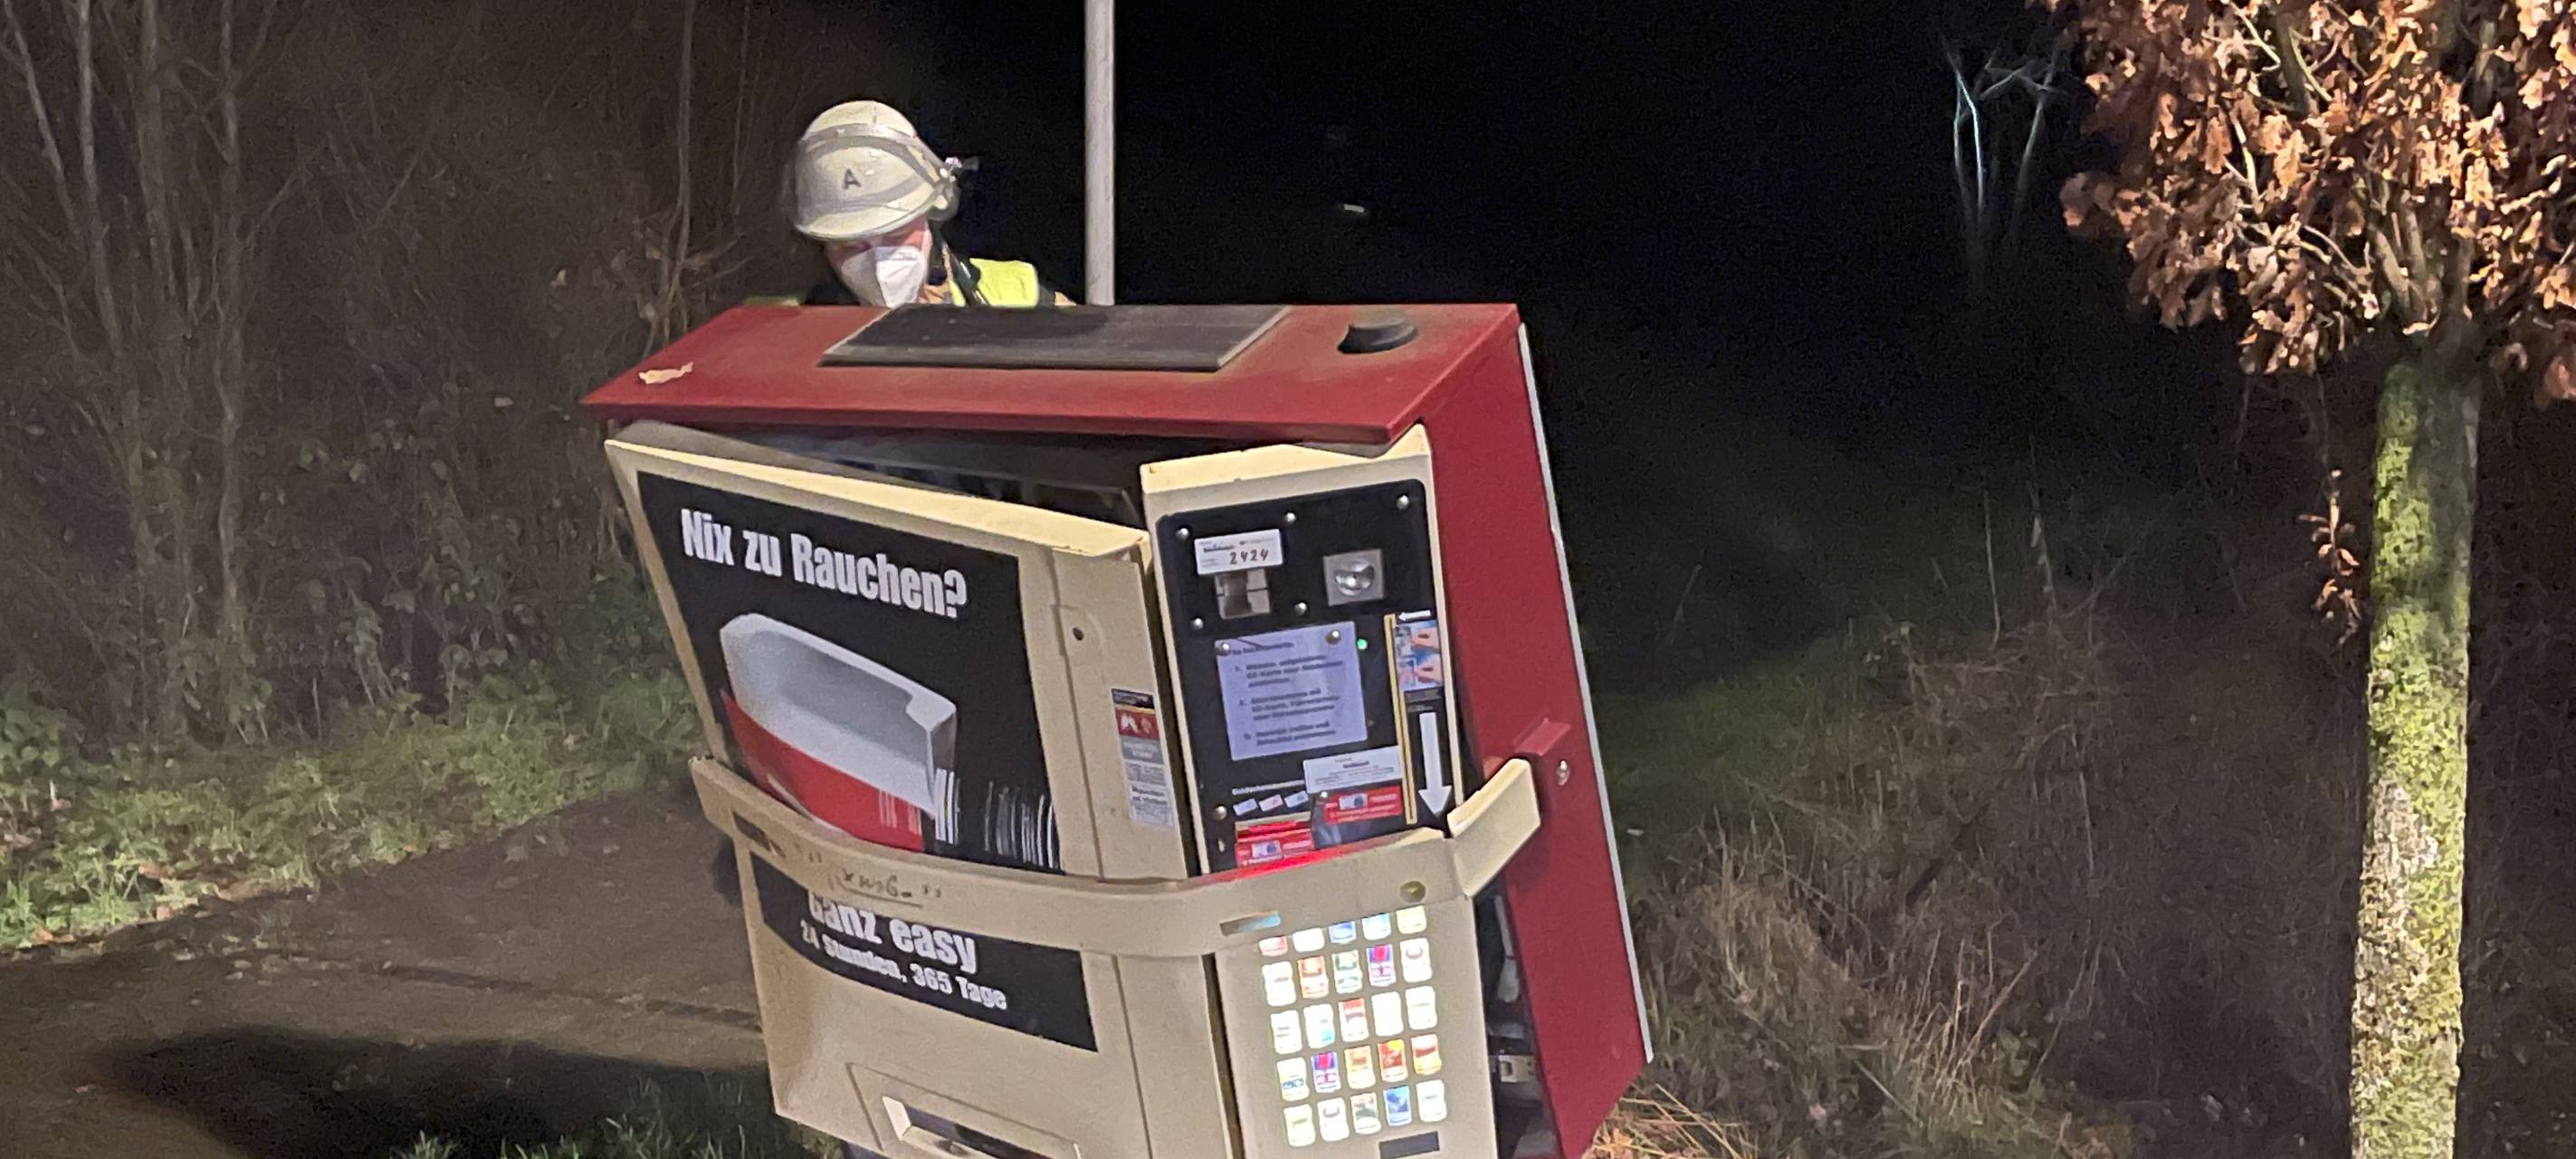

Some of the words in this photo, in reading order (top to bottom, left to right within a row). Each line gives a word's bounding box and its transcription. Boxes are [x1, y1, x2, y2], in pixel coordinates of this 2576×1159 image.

[843, 168, 862, 190] A
[681, 508, 734, 566] Nix
[743, 530, 782, 577] zu
[790, 532, 967, 618] Rauchen?
[1229, 548, 1269, 565] 2424
[807, 890, 883, 944] Ganz
[889, 917, 977, 974] easy
[821, 934, 908, 983] Stunden,
[910, 963, 952, 994] 365
[956, 976, 1007, 1010] Tage
